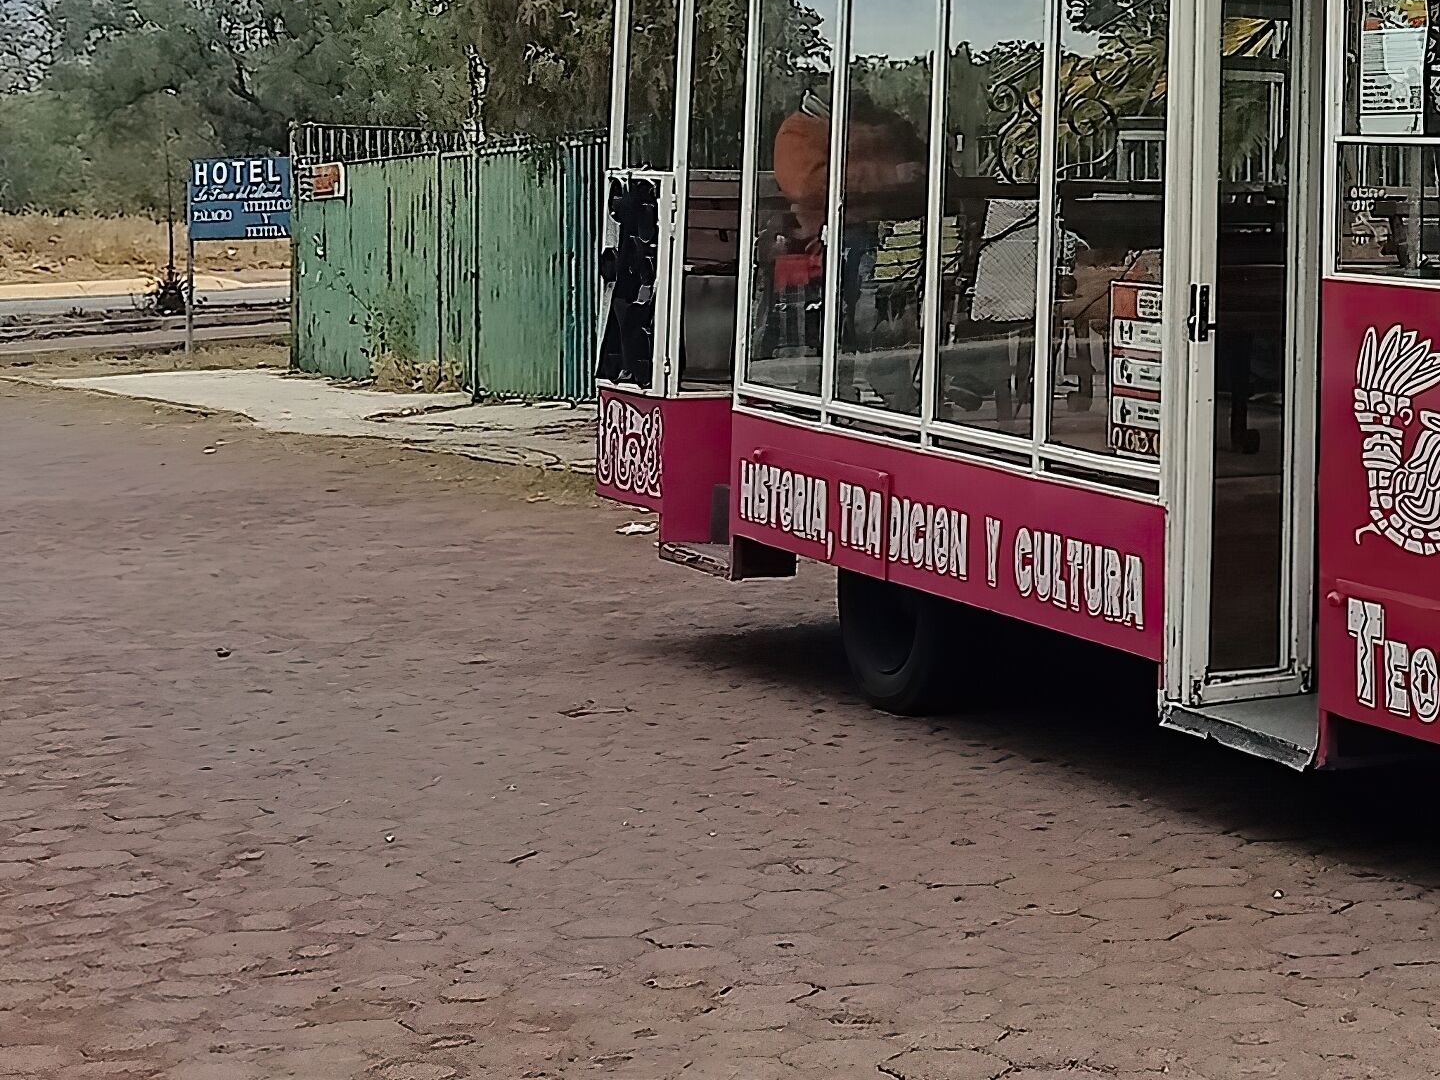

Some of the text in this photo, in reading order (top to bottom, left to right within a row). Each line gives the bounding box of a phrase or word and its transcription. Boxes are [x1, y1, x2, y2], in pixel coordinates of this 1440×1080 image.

[194, 160, 281, 186] HOTEL
[984, 516, 1001, 588] Y
[1014, 526, 1144, 630] CULTURA
